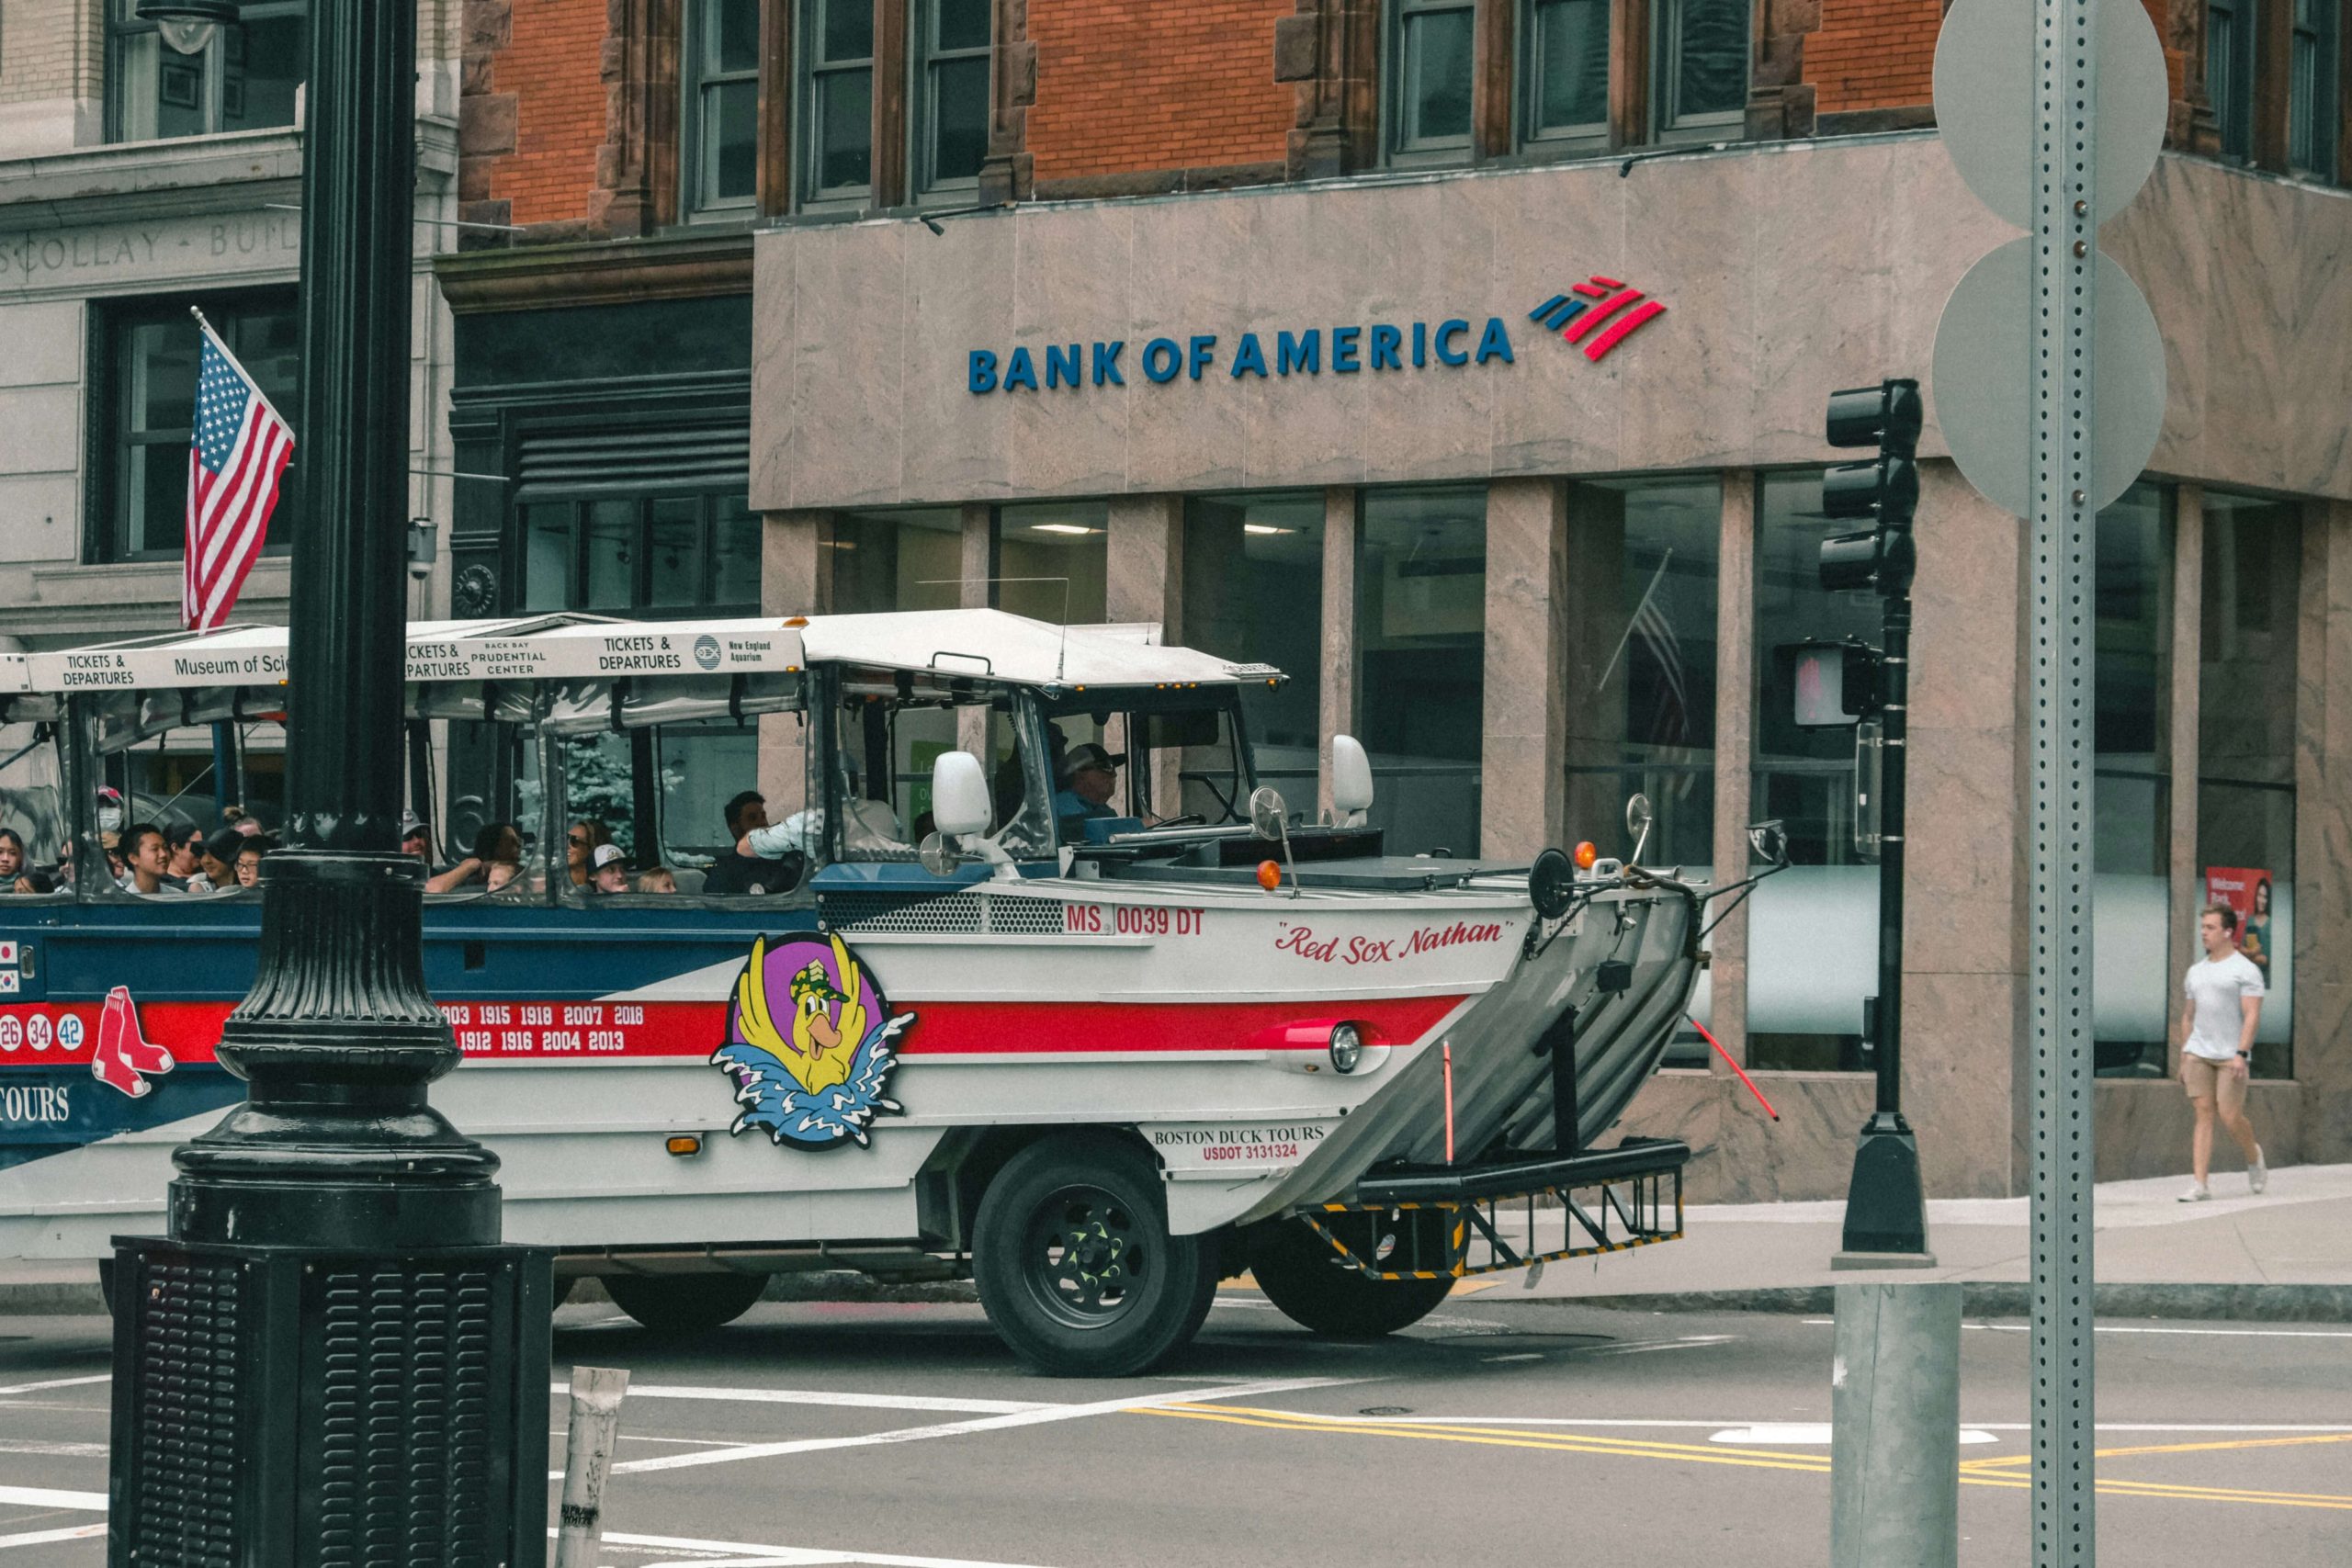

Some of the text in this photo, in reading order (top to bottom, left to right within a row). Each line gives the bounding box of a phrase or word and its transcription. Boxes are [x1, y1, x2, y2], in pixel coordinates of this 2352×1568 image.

[968, 317, 1515, 393] BANK OF AMERICA
[405, 644, 458, 659] CKETS &
[604, 637, 672, 652] TICKETS &
[729, 640, 771, 652] New England
[67, 655, 125, 669] TICKETS &
[471, 651, 547, 662] PRUDENTIAL
[599, 654, 681, 671] DEPARTURES
[730, 652, 762, 663] Aquarium
[175, 657, 240, 676] Museum
[243, 655, 258, 673] of
[405, 661, 470, 678] PARTURES
[487, 664, 534, 675] CENTER
[63, 671, 134, 685] DEPARTURES
[1067, 905, 1205, 935] MS 0039 DT
[1340, 935, 1396, 964] Sox
[440, 1005, 644, 1026] 903 1915 1918 2007 2018
[1, 1020, 19, 1045] 26
[30, 1020, 49, 1044] 34
[59, 1019, 79, 1043] 42
[459, 1031, 625, 1051] 1912 1916 2004 2013
[1155, 1125, 1325, 1145] BOSTON DUCK TOURS
[1204, 1144, 1297, 1161] USDOT 3131324
